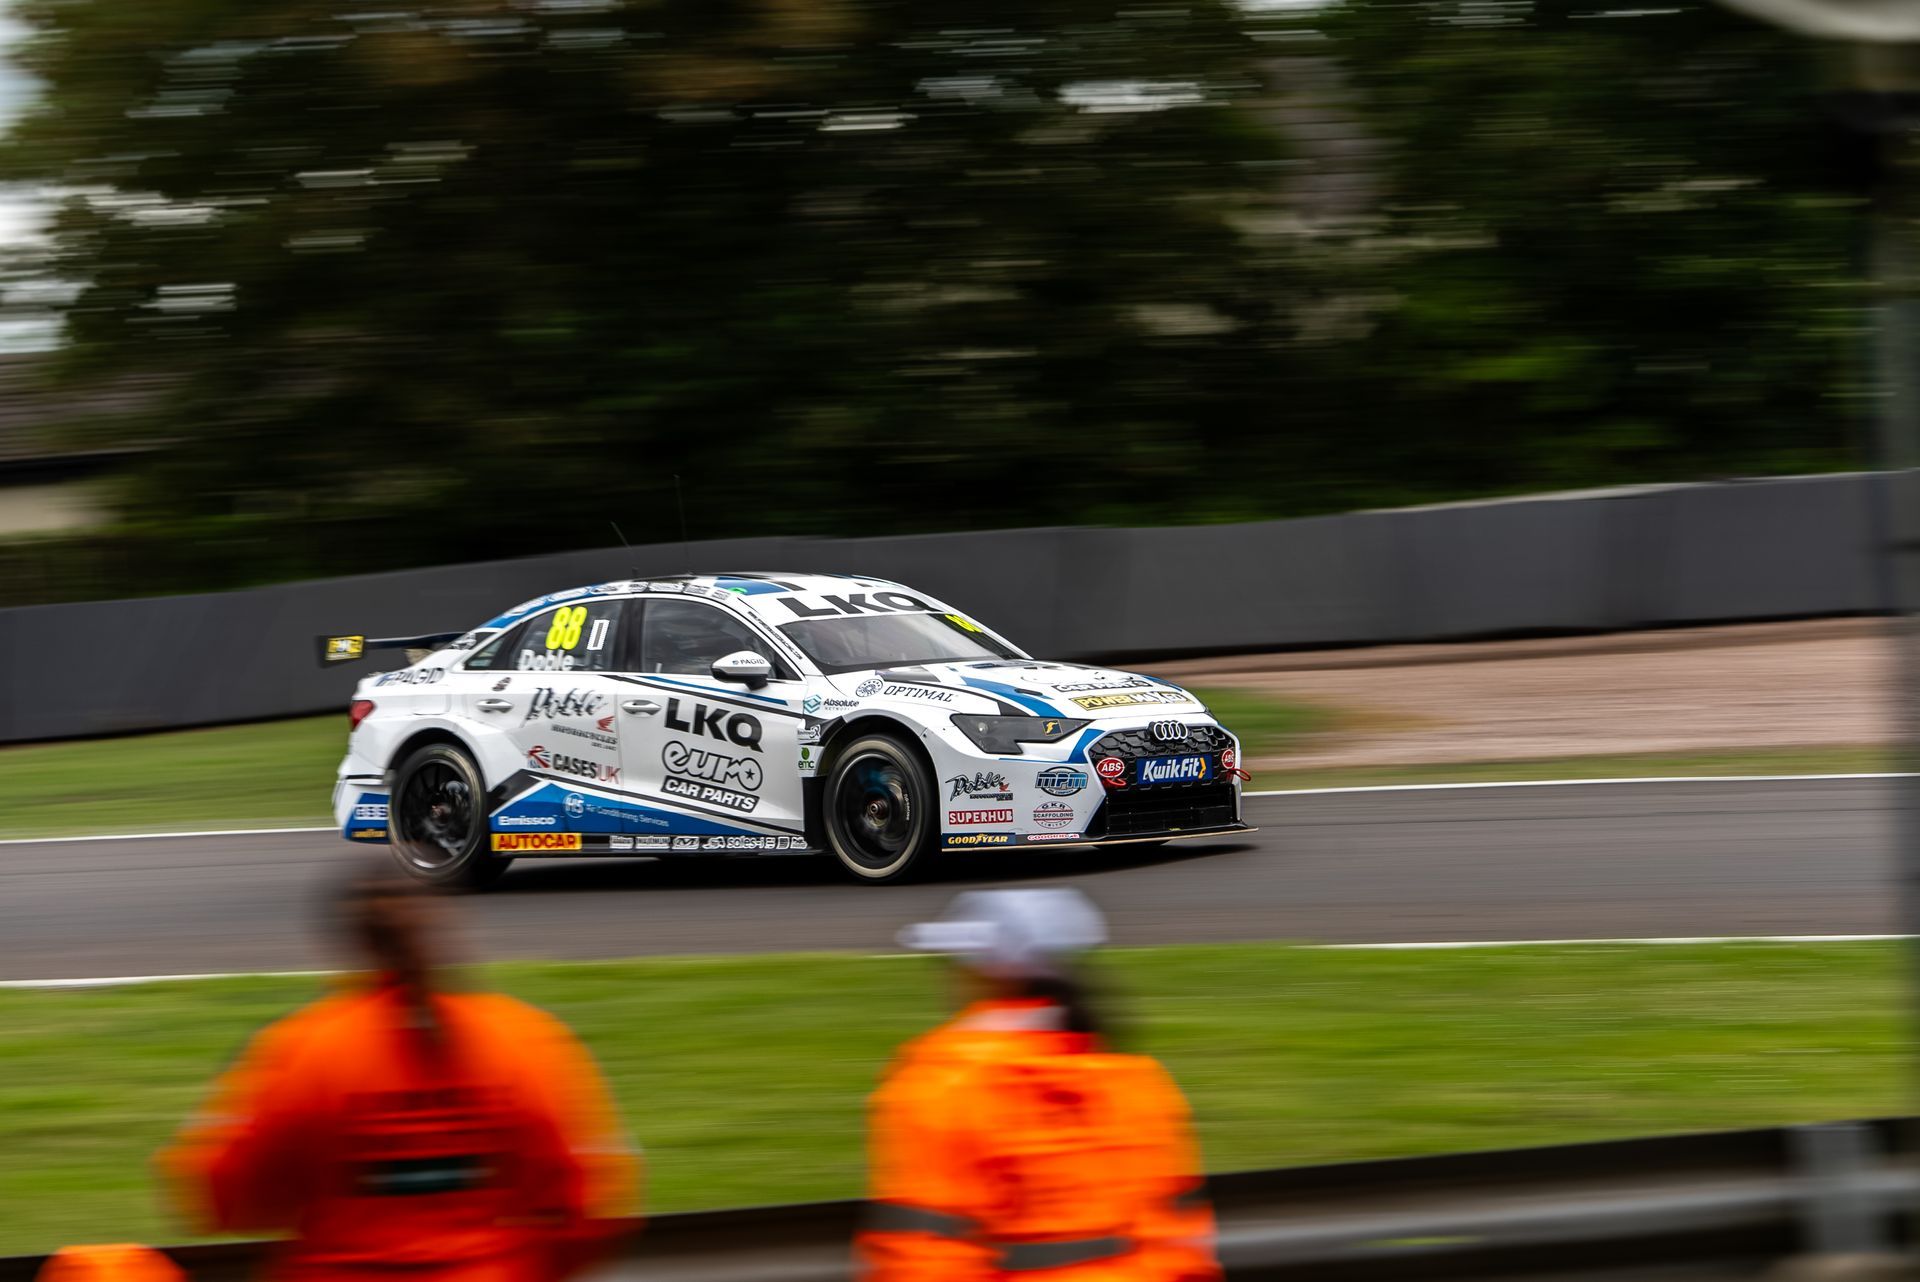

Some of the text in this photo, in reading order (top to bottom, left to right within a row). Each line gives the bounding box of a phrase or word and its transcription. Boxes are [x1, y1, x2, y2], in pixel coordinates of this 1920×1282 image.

[776, 591, 946, 617] LKQ
[545, 606, 588, 650] 88
[518, 649, 575, 671] Doble
[823, 698, 860, 707] Absolute
[884, 685, 953, 703] OPTIMAL
[664, 697, 764, 753] LKQ
[552, 753, 598, 779] CASES
[662, 740, 763, 791] euro
[798, 760, 815, 769] emc
[1101, 762, 1121, 773] ABS
[1142, 757, 1200, 782] KwikFit
[665, 779, 756, 809] CAR PARTS
[949, 810, 1012, 824] SUPERHUB
[498, 835, 576, 849] AUTOCAR
[947, 834, 1009, 845] GOODYEAR
